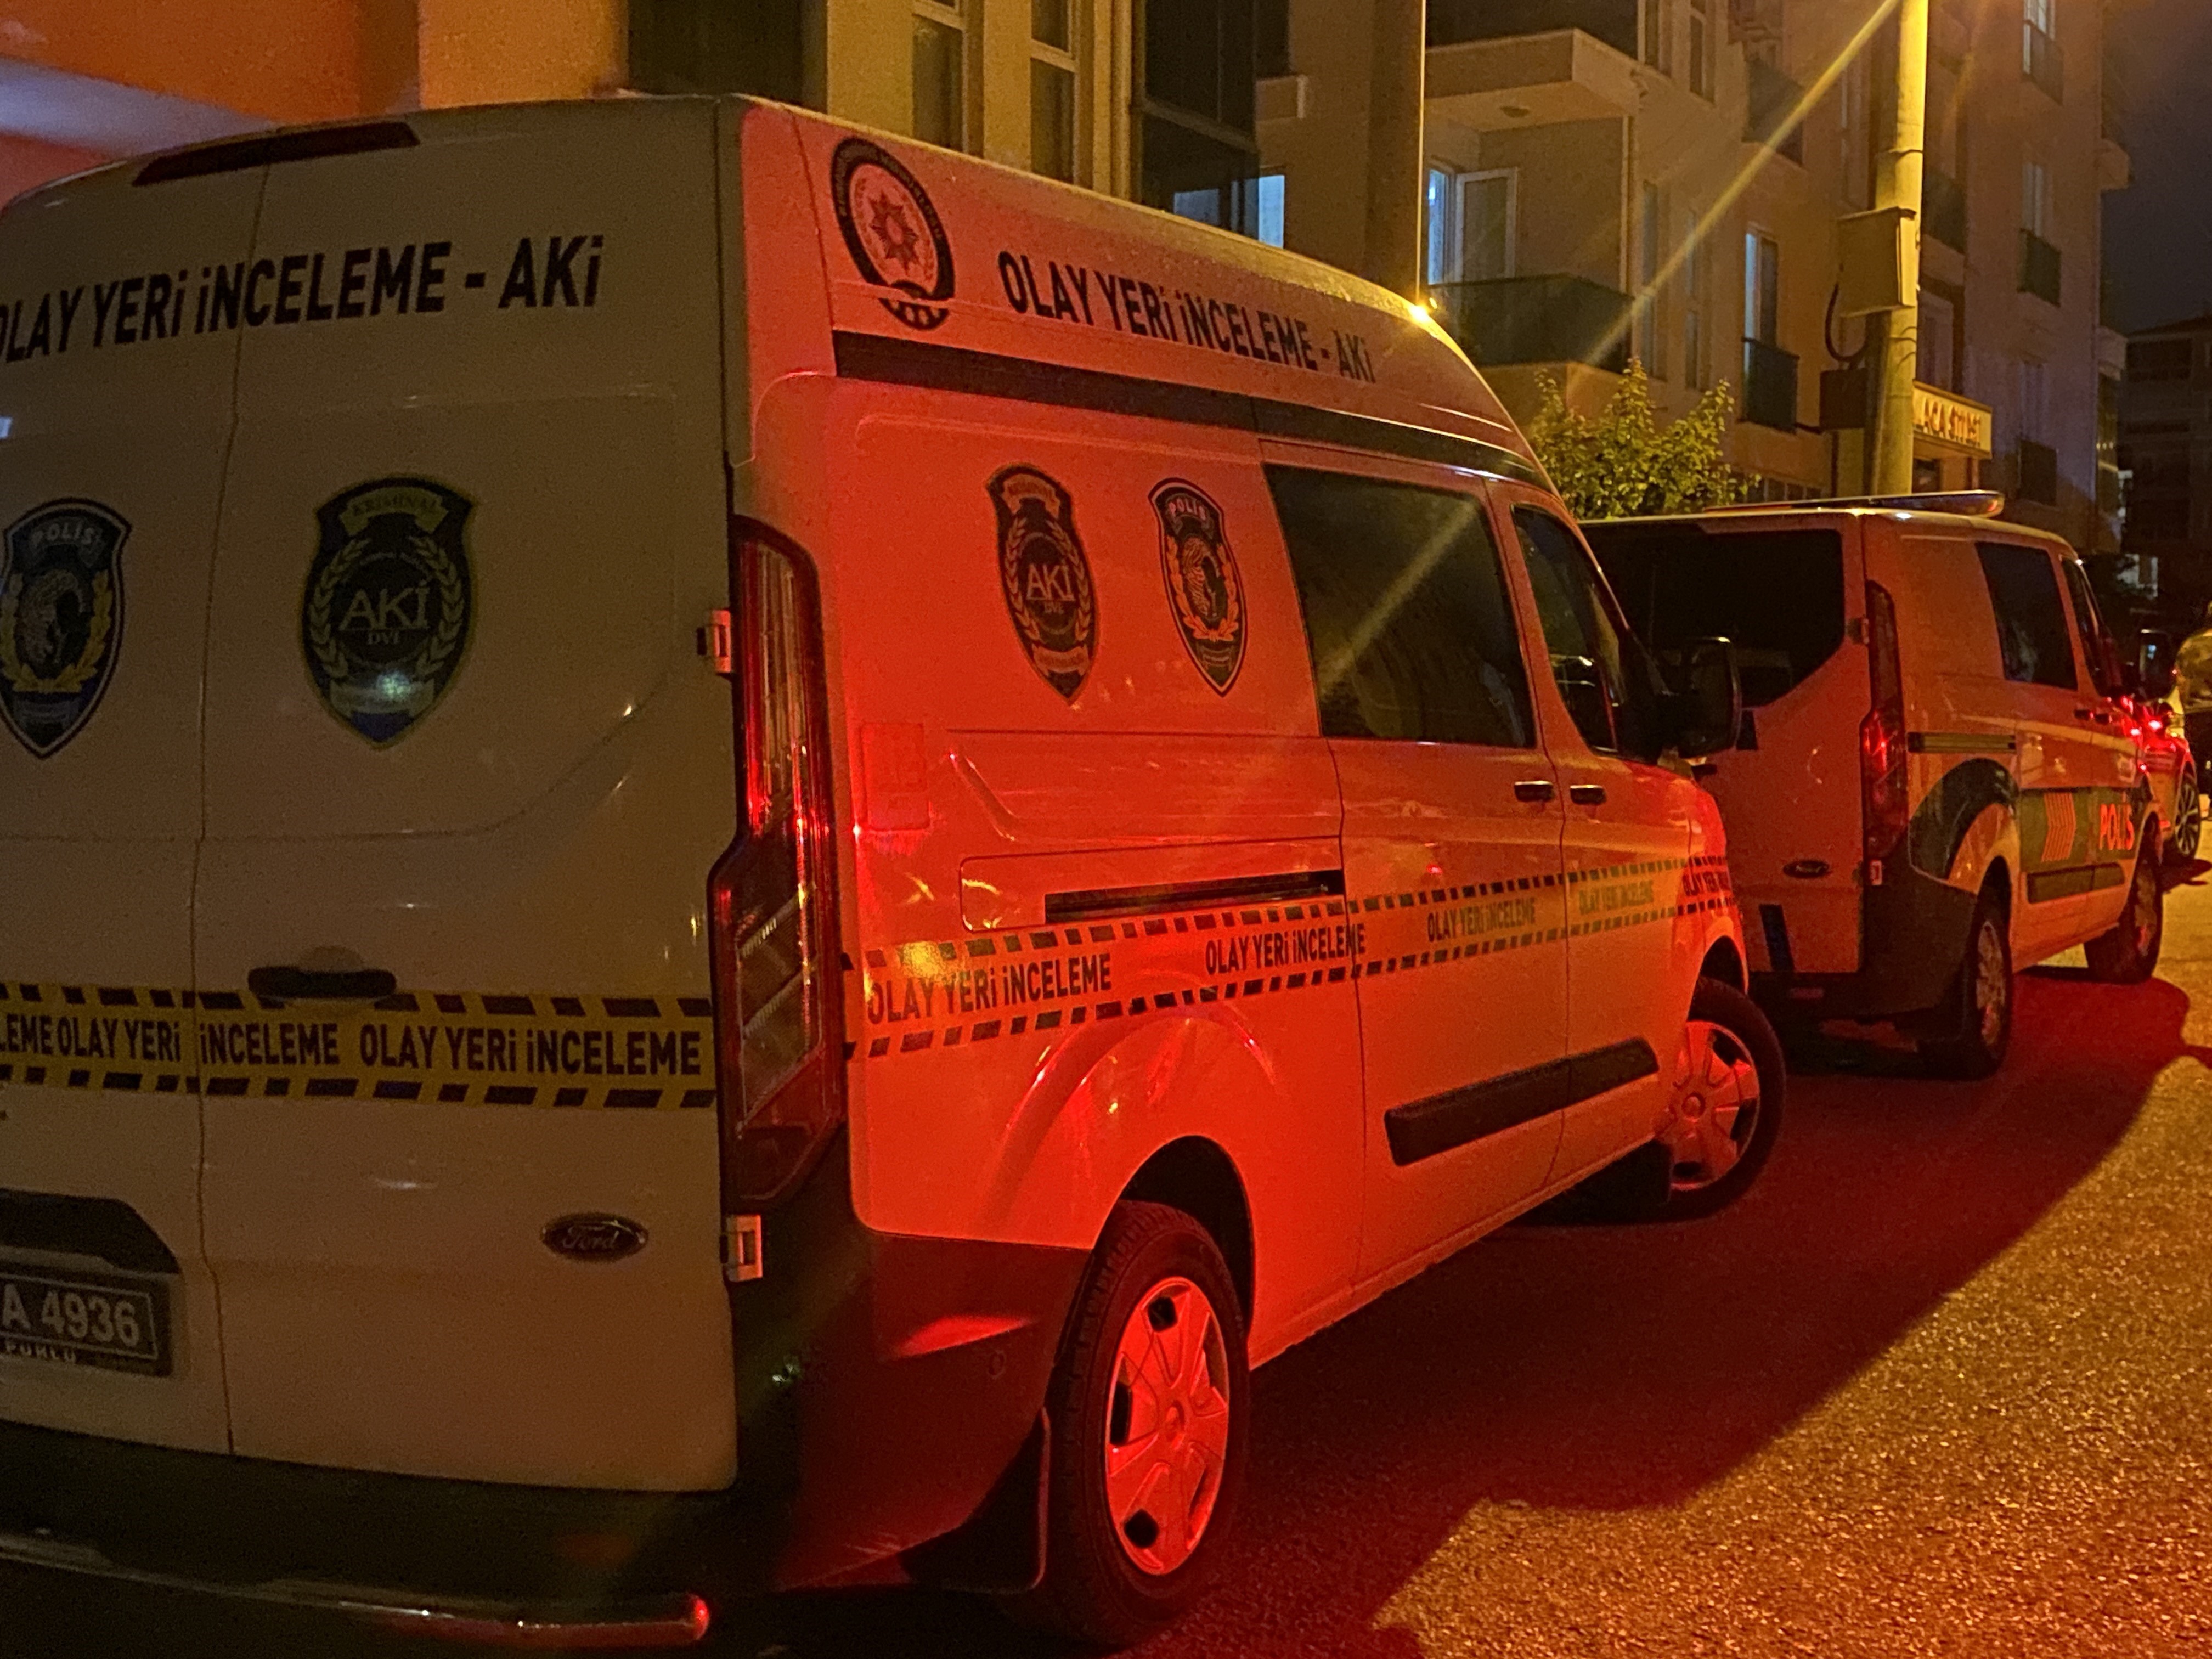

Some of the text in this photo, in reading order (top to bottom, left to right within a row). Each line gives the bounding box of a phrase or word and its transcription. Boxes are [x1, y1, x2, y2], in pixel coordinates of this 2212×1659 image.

[998, 251, 1094, 326] OLAY
[1206, 935, 1249, 975] OLAY
[868, 977, 933, 1024] OLAY
[0, 1013, 53, 1055] EME
[57, 1017, 118, 1058] OLAY
[360, 1023, 438, 1069] OLAY
[40, 1289, 139, 1348] 4936
